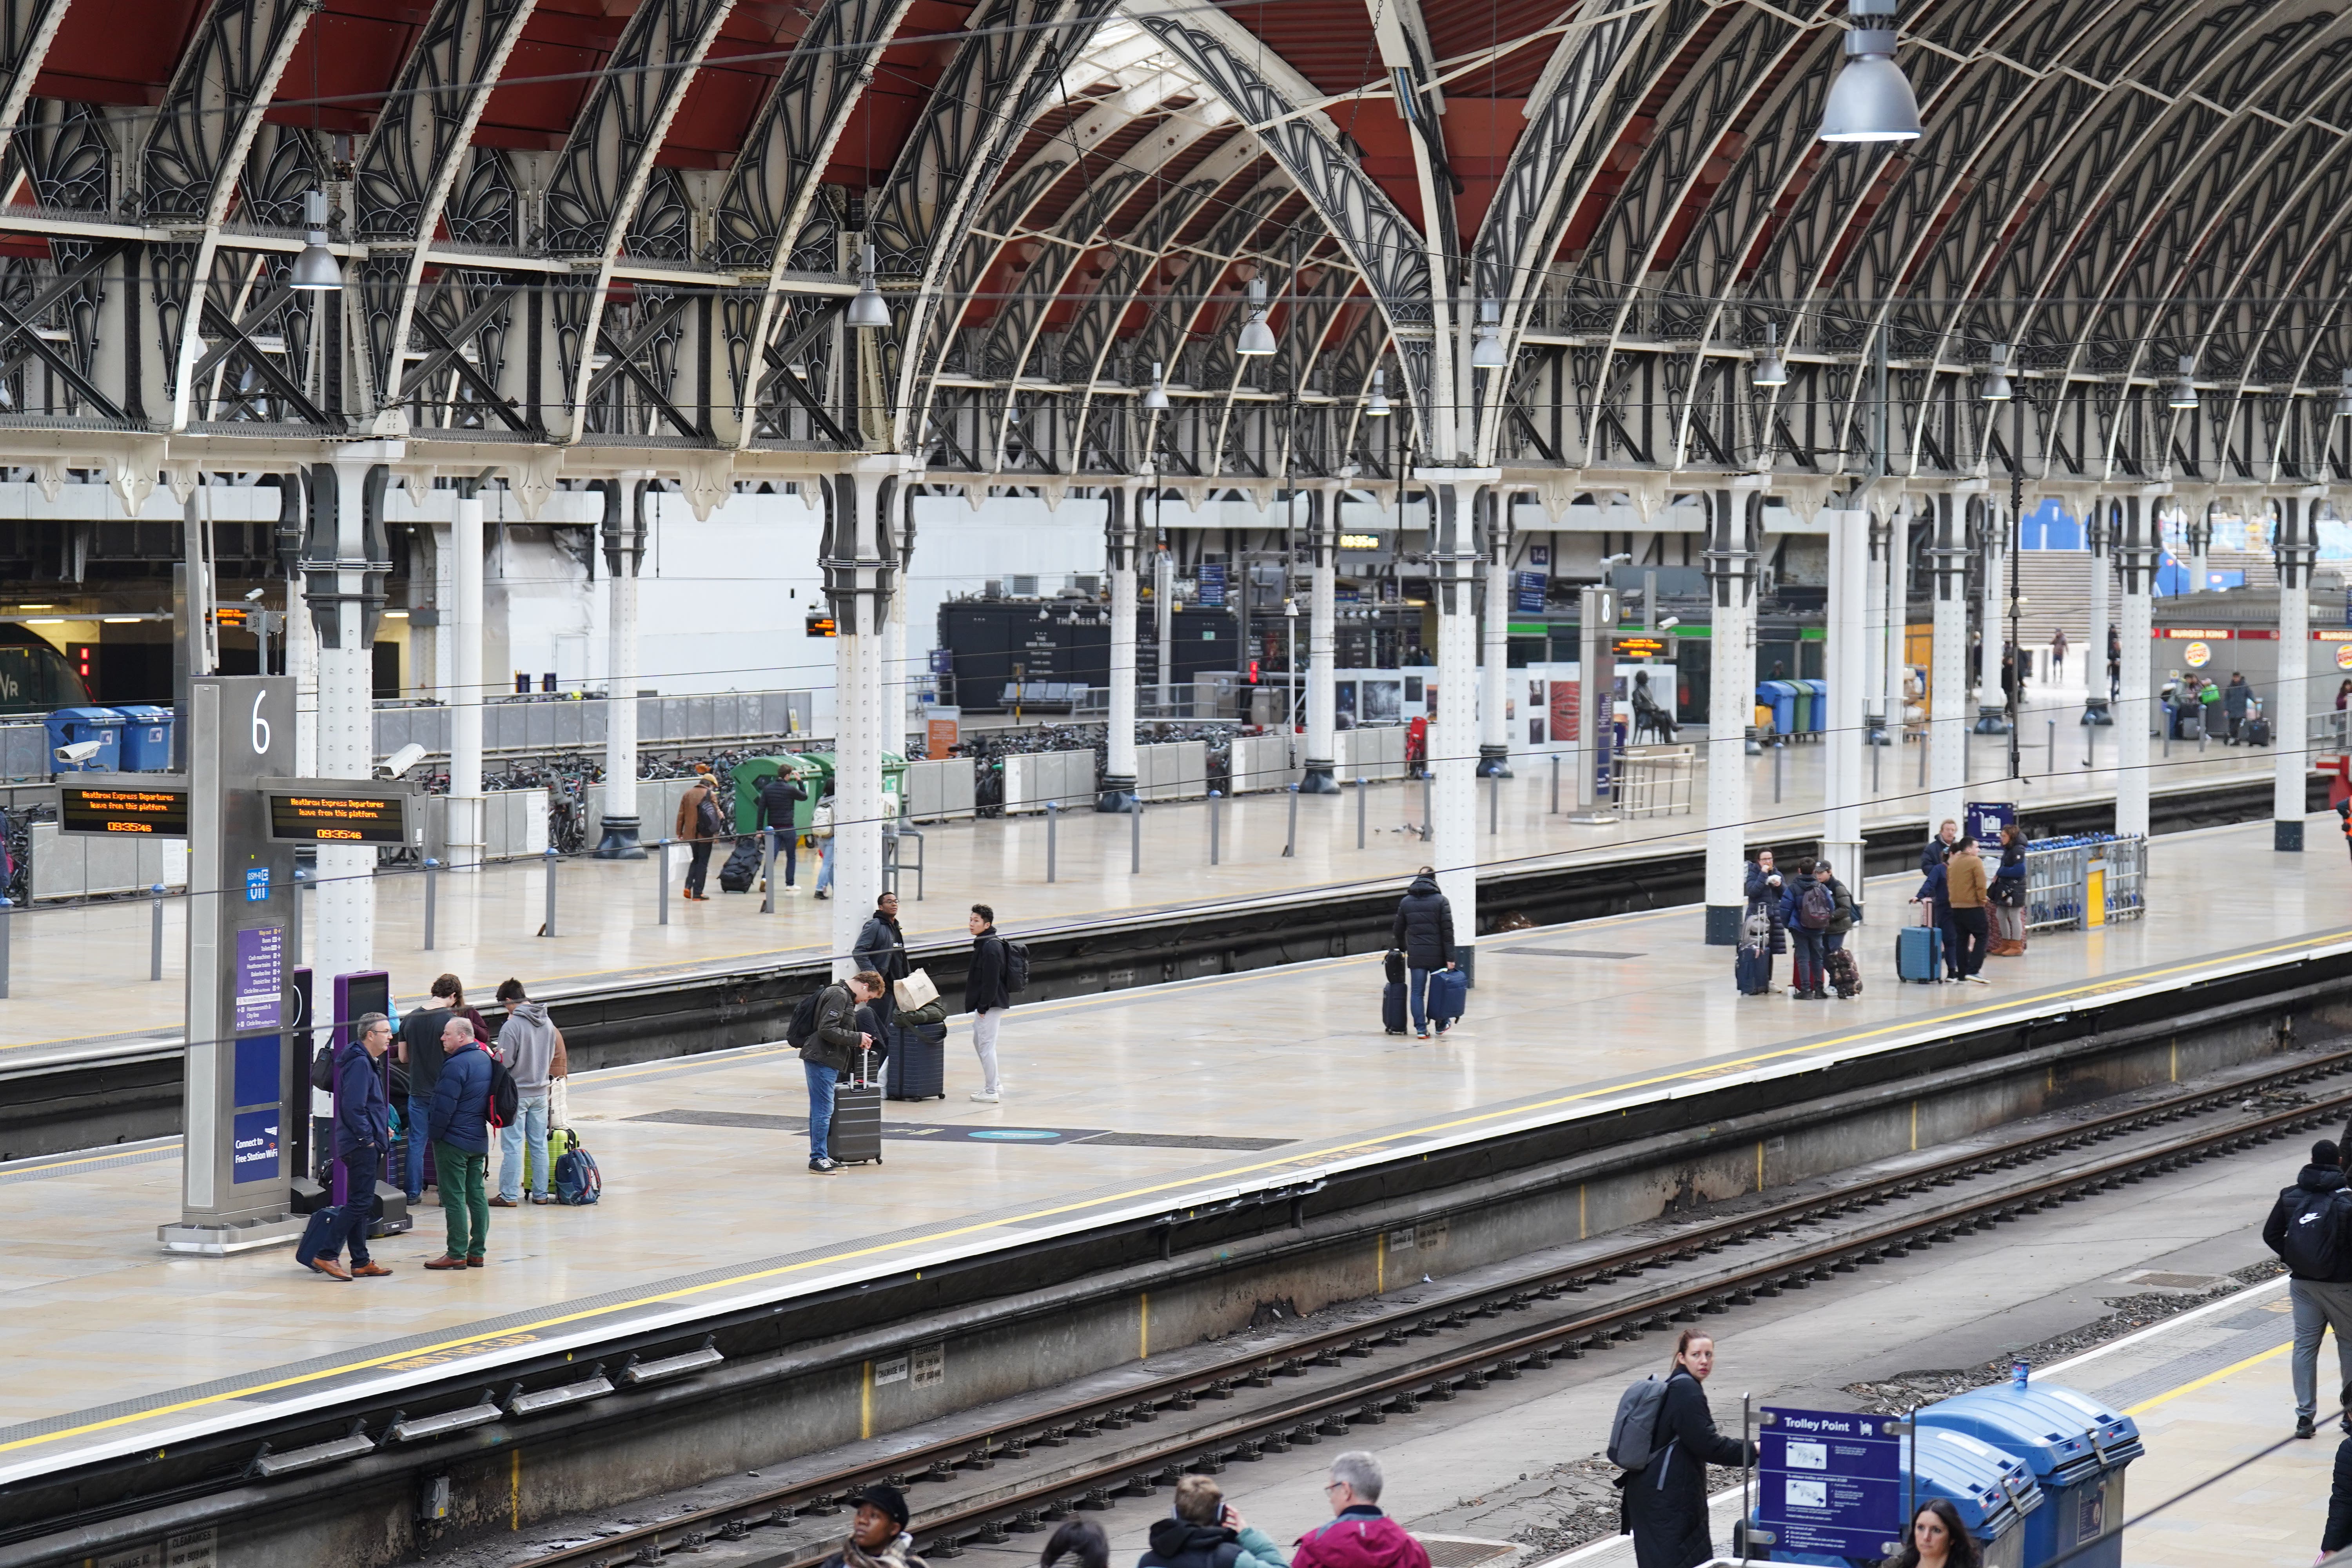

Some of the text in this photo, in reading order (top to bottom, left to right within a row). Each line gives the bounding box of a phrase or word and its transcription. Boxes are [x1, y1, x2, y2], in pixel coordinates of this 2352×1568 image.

[1533, 549, 1546, 561] 14
[1602, 594, 1610, 622] 8
[2170, 630, 2228, 639] BURGER KING
[252, 690, 270, 754] 6
[112, 792, 137, 800] Express
[139, 793, 174, 802] Departures
[139, 803, 168, 811] platform.
[321, 799, 347, 808] Express
[348, 800, 384, 808] Departures
[107, 822, 152, 832] 09:35:46
[317, 829, 362, 839] 09:35:46
[250, 882, 265, 899] 011
[235, 1138, 257, 1149] Connect
[235, 1148, 278, 1163] Free Station WiFi
[376, 1334, 542, 1371] MIND THE GAP
[1784, 1417, 1850, 1432] Trolley Point
